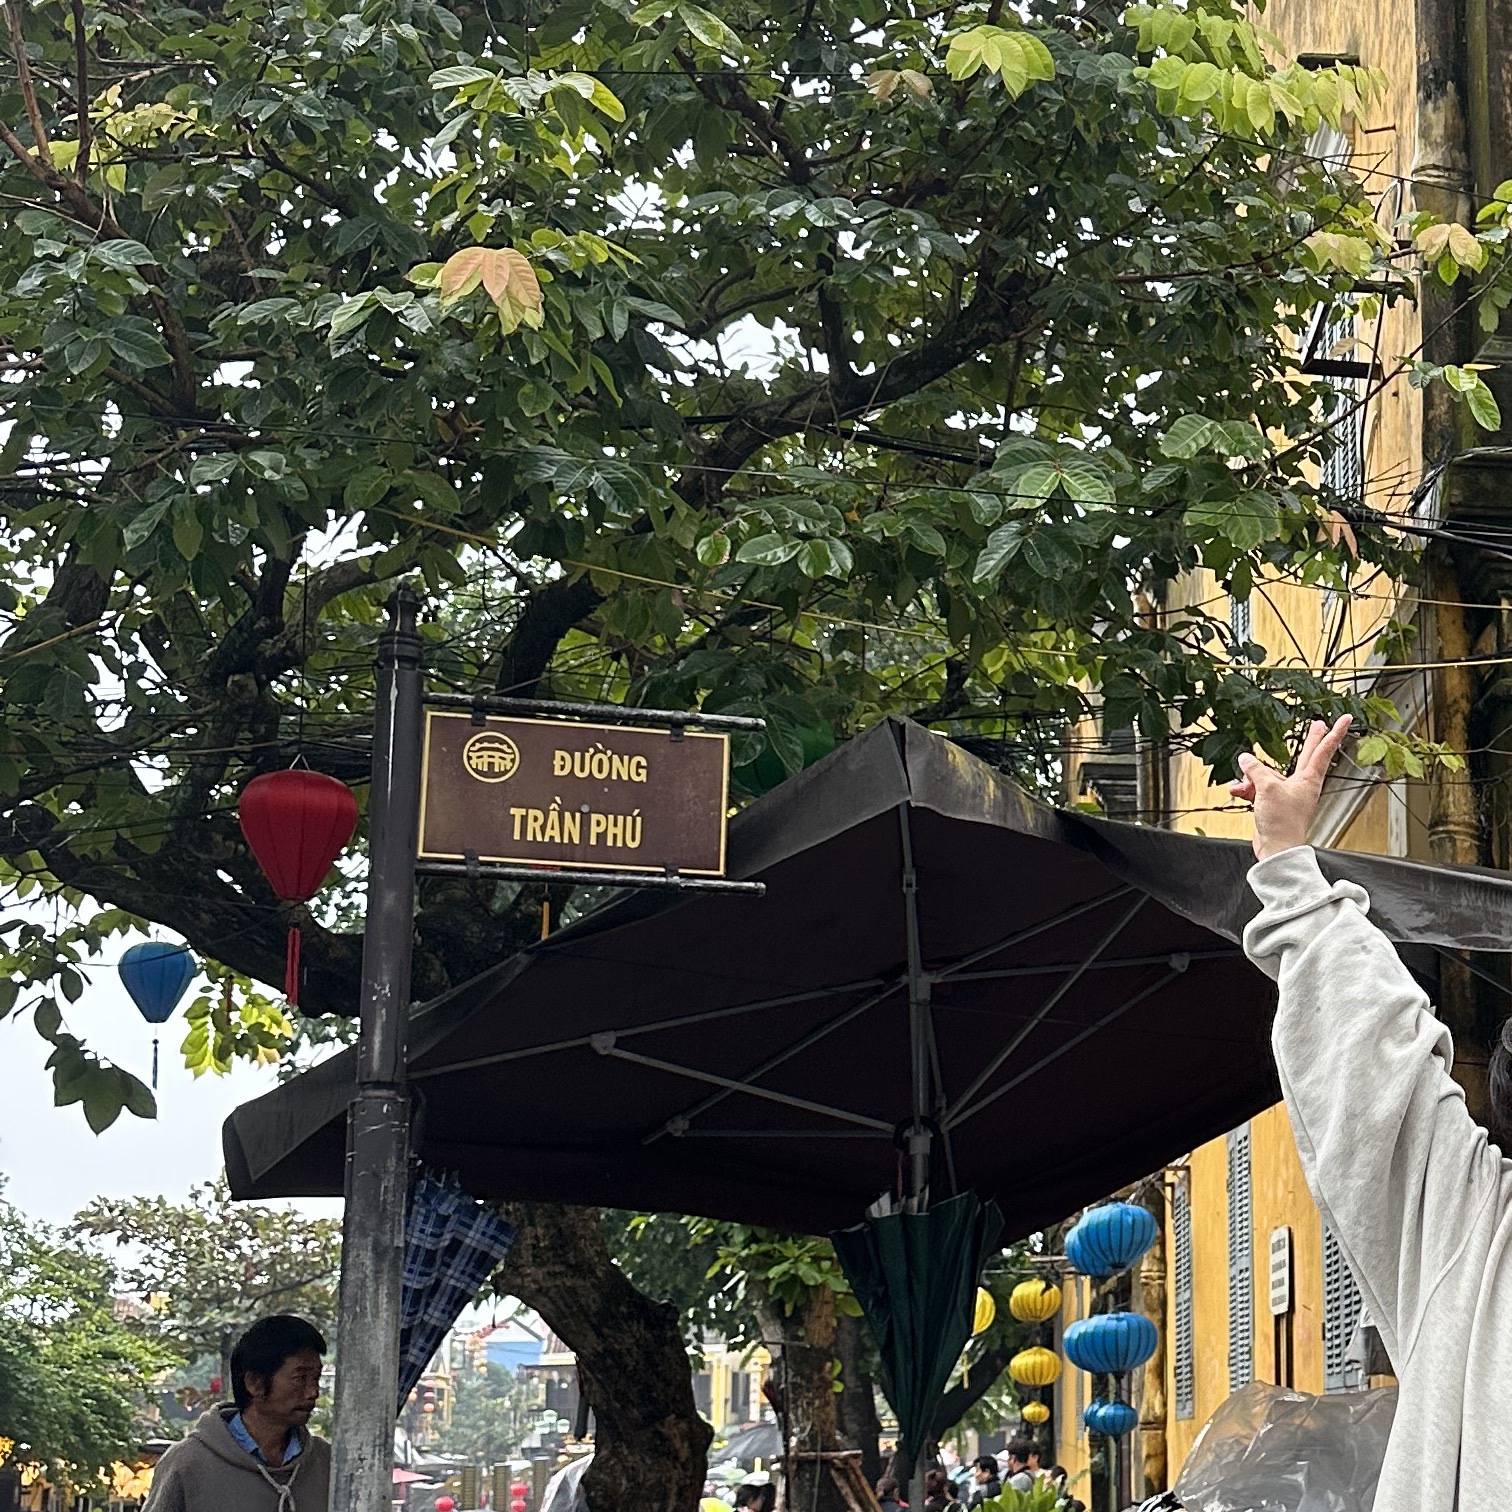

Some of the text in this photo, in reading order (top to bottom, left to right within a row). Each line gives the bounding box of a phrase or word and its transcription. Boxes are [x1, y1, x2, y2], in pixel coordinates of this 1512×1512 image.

[553, 742, 647, 782] ĐƯỜNG
[510, 796, 642, 849] TRẦN PHÚ
